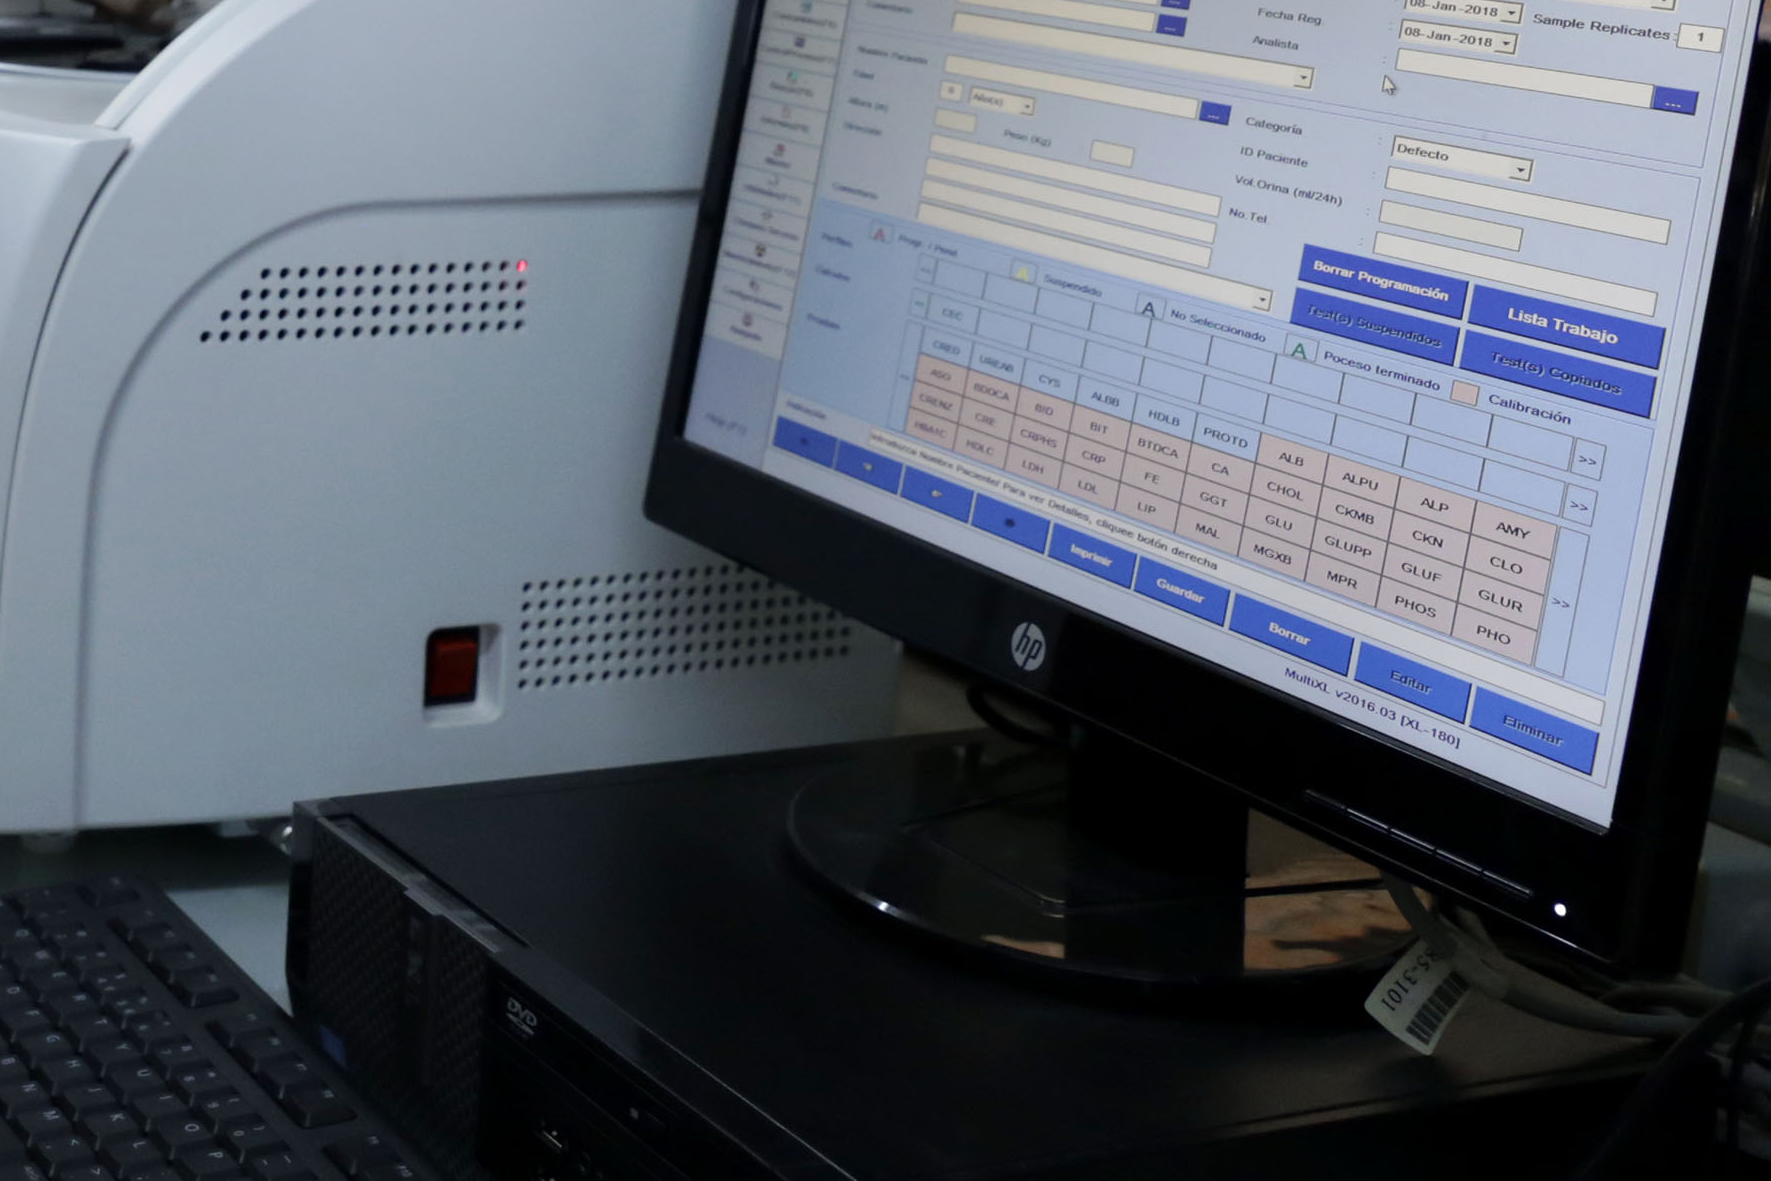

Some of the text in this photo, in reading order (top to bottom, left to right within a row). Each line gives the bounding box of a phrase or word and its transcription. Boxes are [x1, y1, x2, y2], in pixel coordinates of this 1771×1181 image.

[1257, 7, 1294, 21] Fecha
[1532, 13, 1585, 30] Sample
[1252, 35, 1299, 51] Analista
[1698, 32, 1704, 42] 1
[1245, 117, 1303, 136] Categoría
[1240, 146, 1309, 168] ID Paciente
[1397, 143, 1449, 161] Defecto
[1293, 187, 1343, 208] (ml/24h)
[1313, 260, 1450, 302] Borrar Programación
[1139, 301, 1158, 321] A
[1170, 309, 1267, 343] No Seleccionado
[1507, 307, 1619, 344] Lista Trabajo
[1356, 317, 1442, 349] Suspendidos
[1289, 342, 1308, 362] A
[1323, 350, 1441, 391] Poceso terminado
[1491, 351, 1623, 396] Test(s) Copiados
[1488, 394, 1572, 425] Calibración
[1147, 409, 1180, 427] HDLB
[1203, 427, 1249, 449] PROTD
[1278, 452, 1304, 467] ALB
[1341, 472, 1379, 491] ALPU
[1420, 497, 1450, 512] ALP
[1495, 522, 1530, 539] AMY
[1002, 481, 1026, 498] Para
[1029, 494, 1045, 504] ver
[1095, 519, 1134, 539] cliquee
[1136, 533, 1170, 552] botón
[1171, 547, 1218, 571] derecha
[1081, 450, 1106, 464] CRP
[1144, 471, 1160, 484] FE
[1199, 491, 1228, 508] GGT
[1264, 514, 1293, 531] GLU
[1324, 535, 1372, 557] GLUPP
[1401, 562, 1442, 582] GLUF
[1478, 589, 1523, 613] GLUR
[1211, 462, 1229, 476] CA
[1266, 481, 1303, 501] CHOL
[1335, 504, 1375, 525] CKMB
[1412, 530, 1444, 548] CKN
[1489, 556, 1523, 575] CLO
[1021, 459, 1045, 475] LDH
[1077, 479, 1098, 495] LDL
[1137, 501, 1157, 514] LIP
[1195, 522, 1220, 540] MAL
[1253, 543, 1292, 565] MGXB
[1326, 570, 1358, 589] MPR
[1394, 595, 1437, 618] PHOS
[1476, 625, 1511, 645] PHO
[1012, 622, 1046, 671] hp
[1156, 578, 1205, 604] Guardar
[1268, 621, 1311, 646] Borrar
[1390, 669, 1433, 695] Editar
[1502, 714, 1564, 747] Eliminar
[1284, 667, 1461, 750] MultiXL v2016.03 [XL-180]
[506, 996, 538, 1027] DVD
